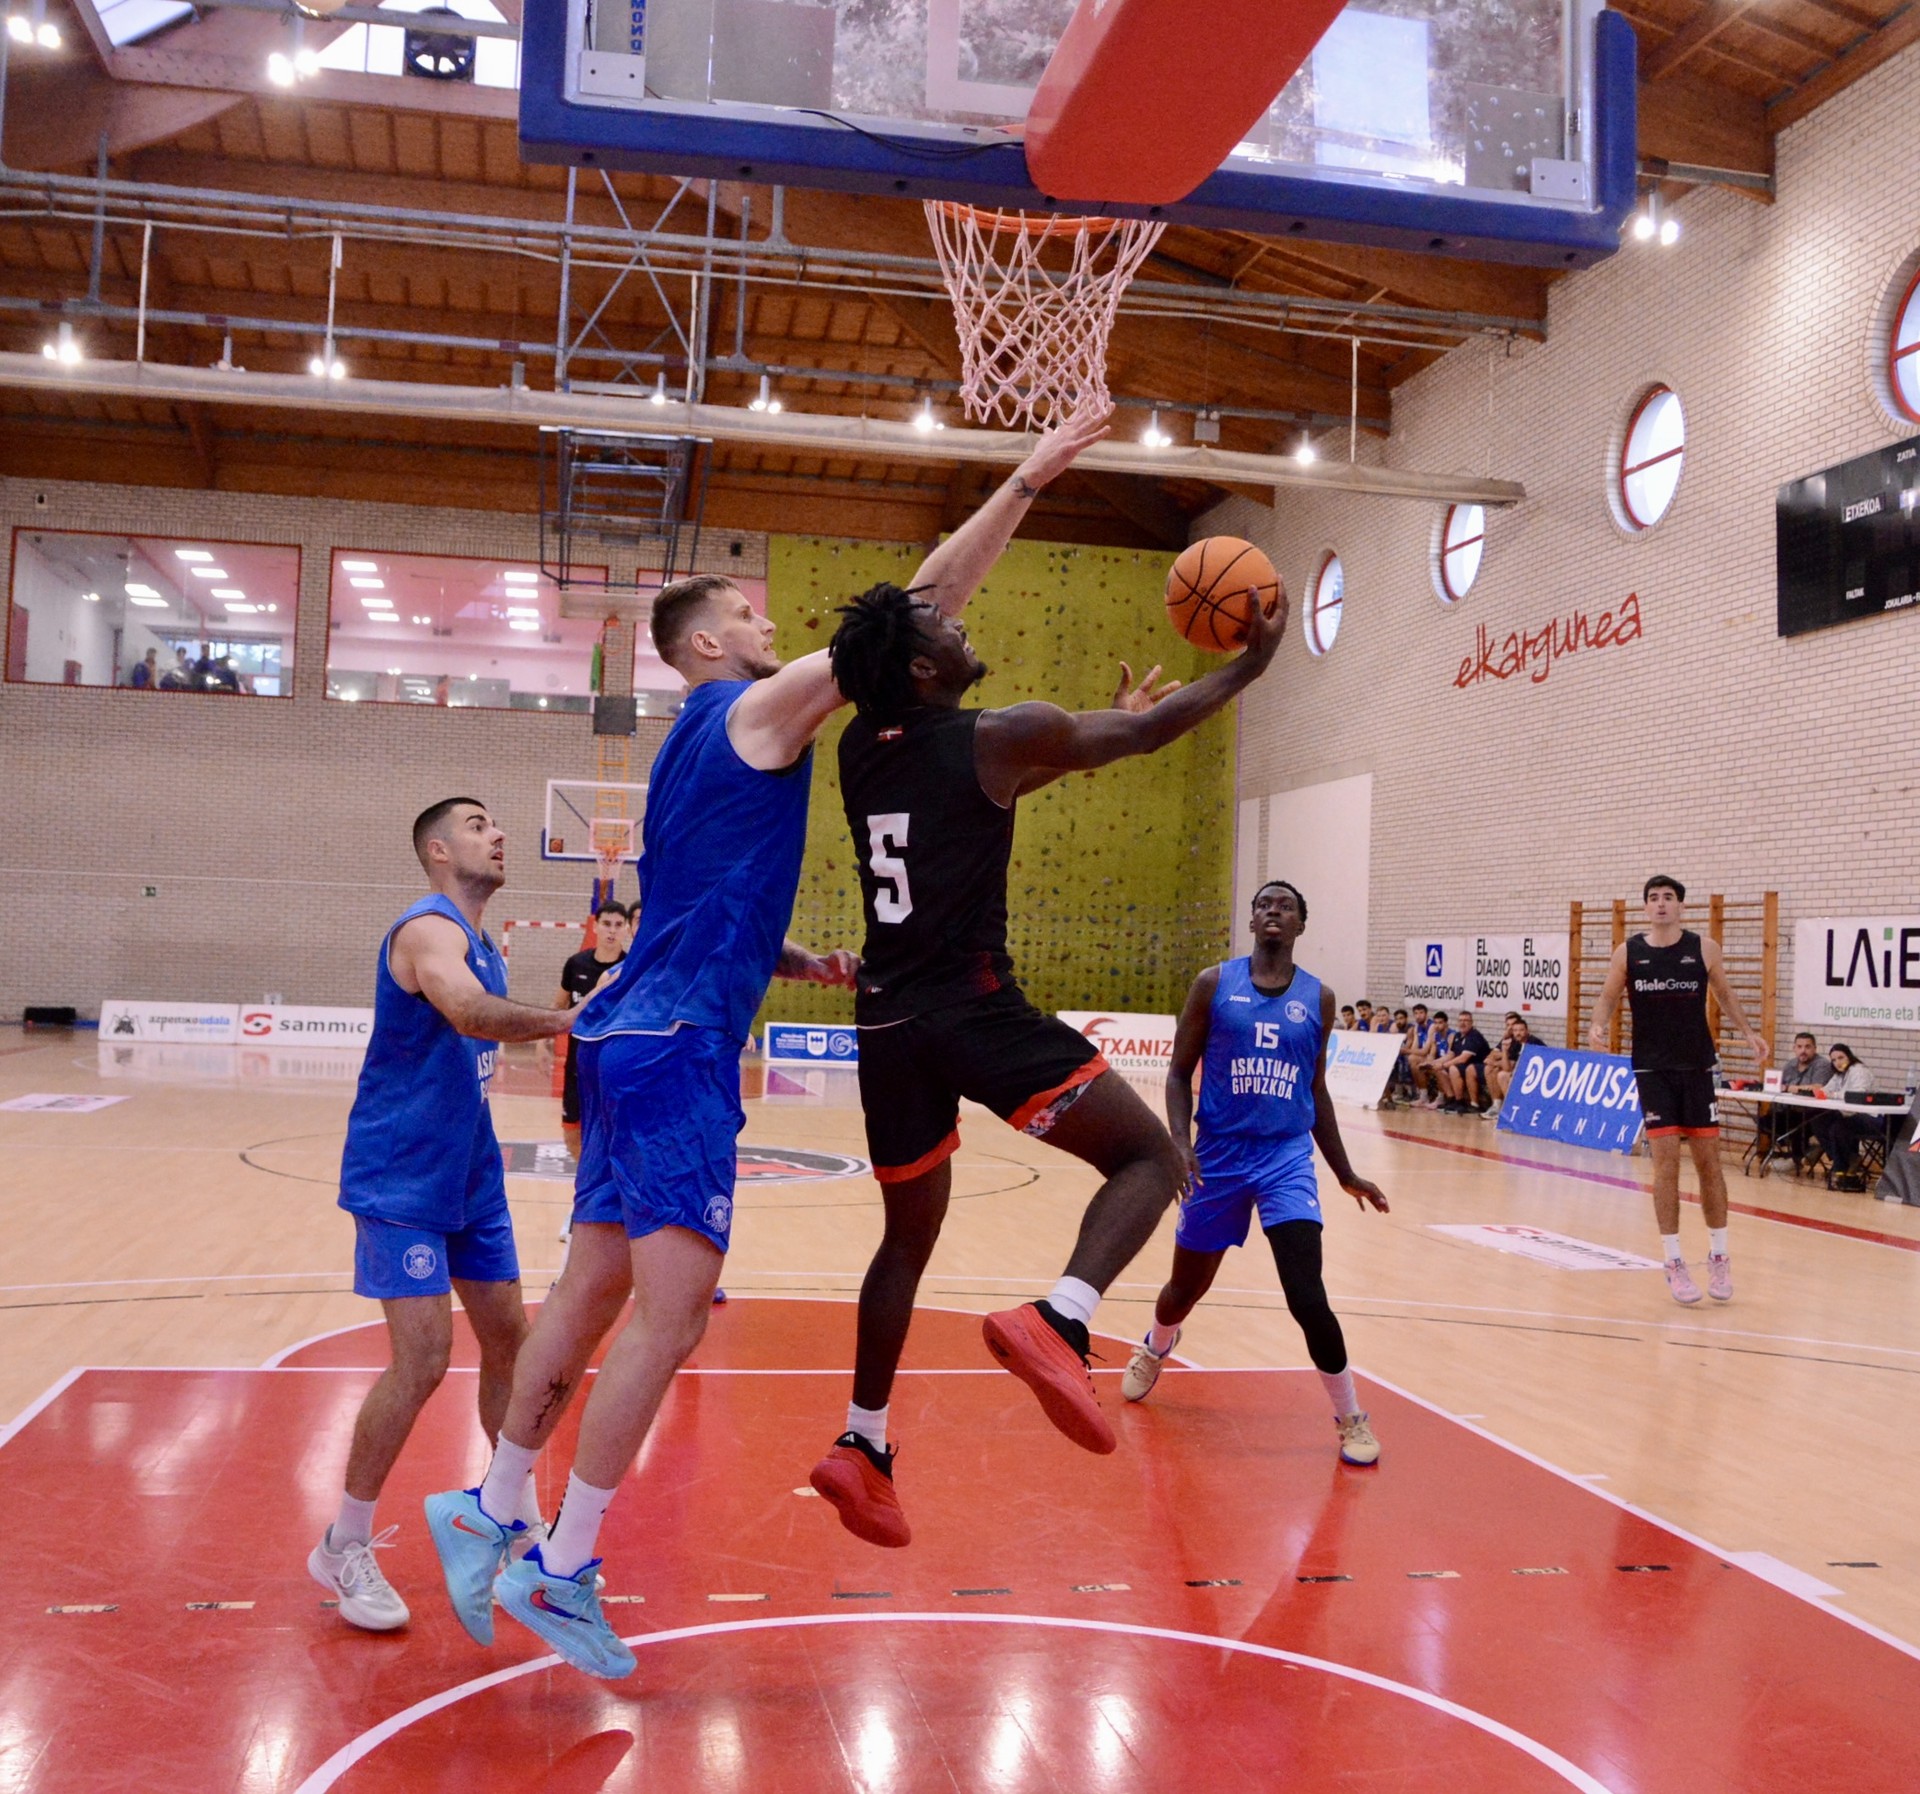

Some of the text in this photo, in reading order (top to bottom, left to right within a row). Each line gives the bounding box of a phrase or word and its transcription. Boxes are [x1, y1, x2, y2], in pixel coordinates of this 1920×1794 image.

[1845, 497, 1881, 523] ETXEKOA
[1452, 591, 1643, 689] elkargunea
[867, 812, 913, 924] 5
[1476, 938, 1488, 956] EL
[1523, 938, 1536, 956] EL
[1476, 959, 1511, 977] DIARIO
[1523, 959, 1561, 978] DIARIO
[1404, 985, 1464, 1000] DANOBATGROUP
[1476, 980, 1509, 998] VASCO
[1522, 981, 1560, 1001] VASCO
[1634, 978, 1699, 992] BieleGroup
[1824, 1002, 1892, 1020] Ingurumena
[1895, 1006, 1914, 1020] eta
[279, 1019, 368, 1033] sammic
[1254, 1022, 1280, 1049] 15
[1231, 1057, 1300, 1083] ASKATUAK
[1232, 1076, 1293, 1100] GIPUZKOA
[1520, 1055, 1639, 1112] DOMUSA
